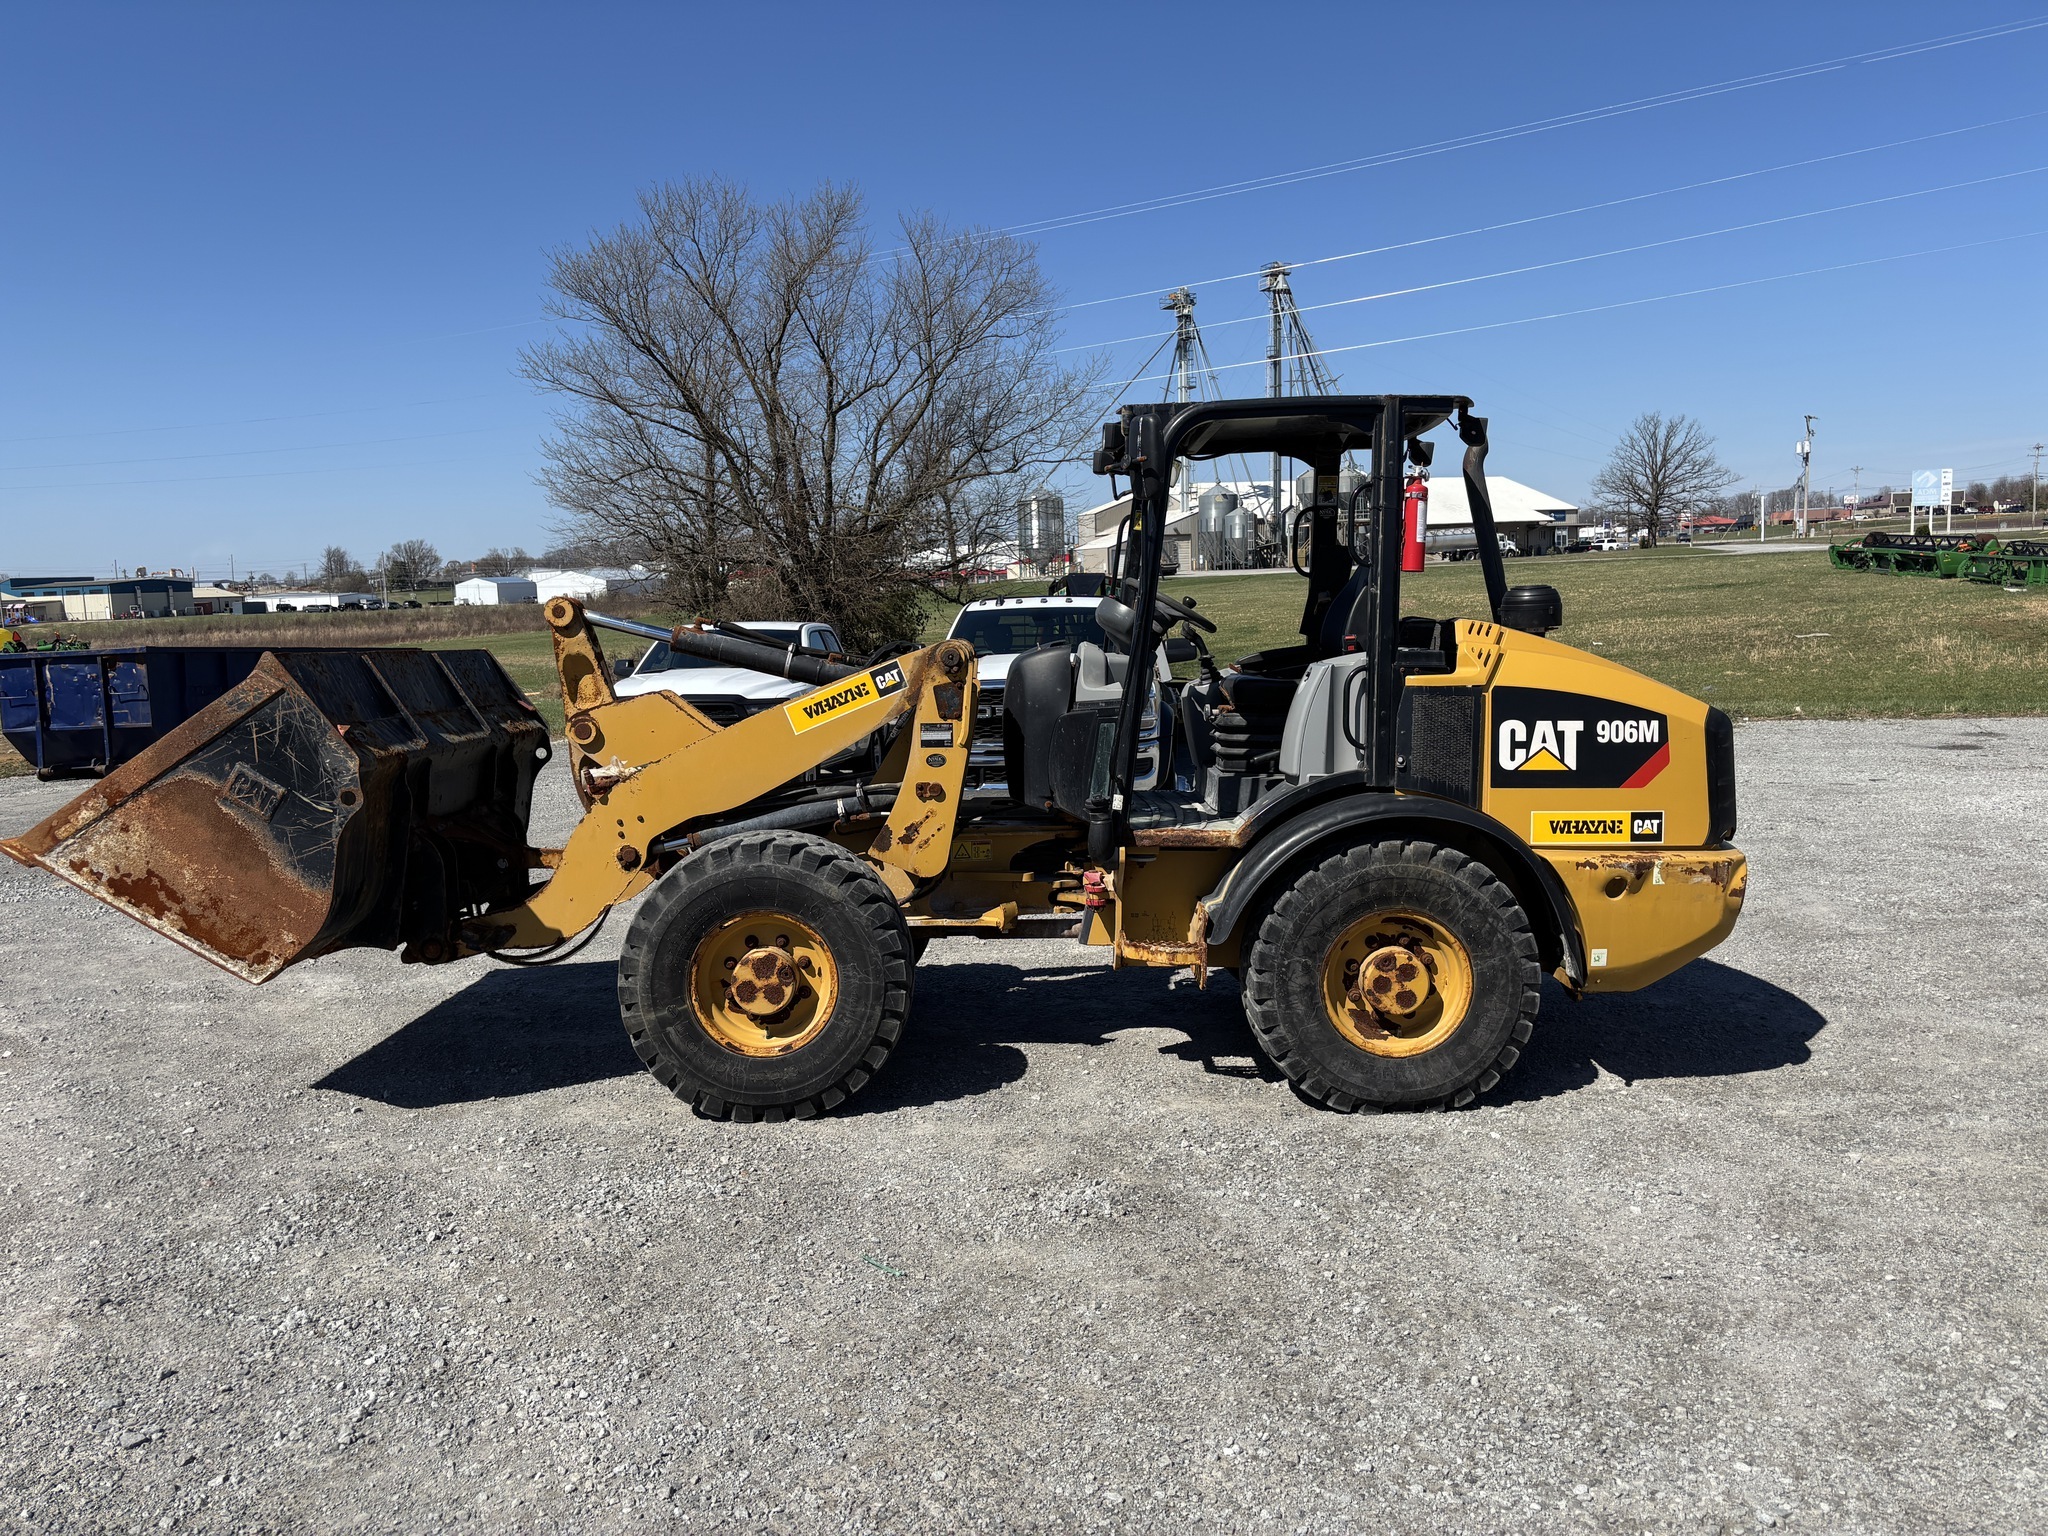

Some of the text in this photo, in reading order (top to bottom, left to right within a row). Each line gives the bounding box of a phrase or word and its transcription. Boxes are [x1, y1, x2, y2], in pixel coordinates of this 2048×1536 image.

[803, 682, 870, 719] WHAYNE
[875, 669, 900, 690] CAT
[1499, 720, 1584, 770] CAT
[1597, 720, 1659, 743] 906M
[1549, 820, 1660, 835] WHAYNE CAT
